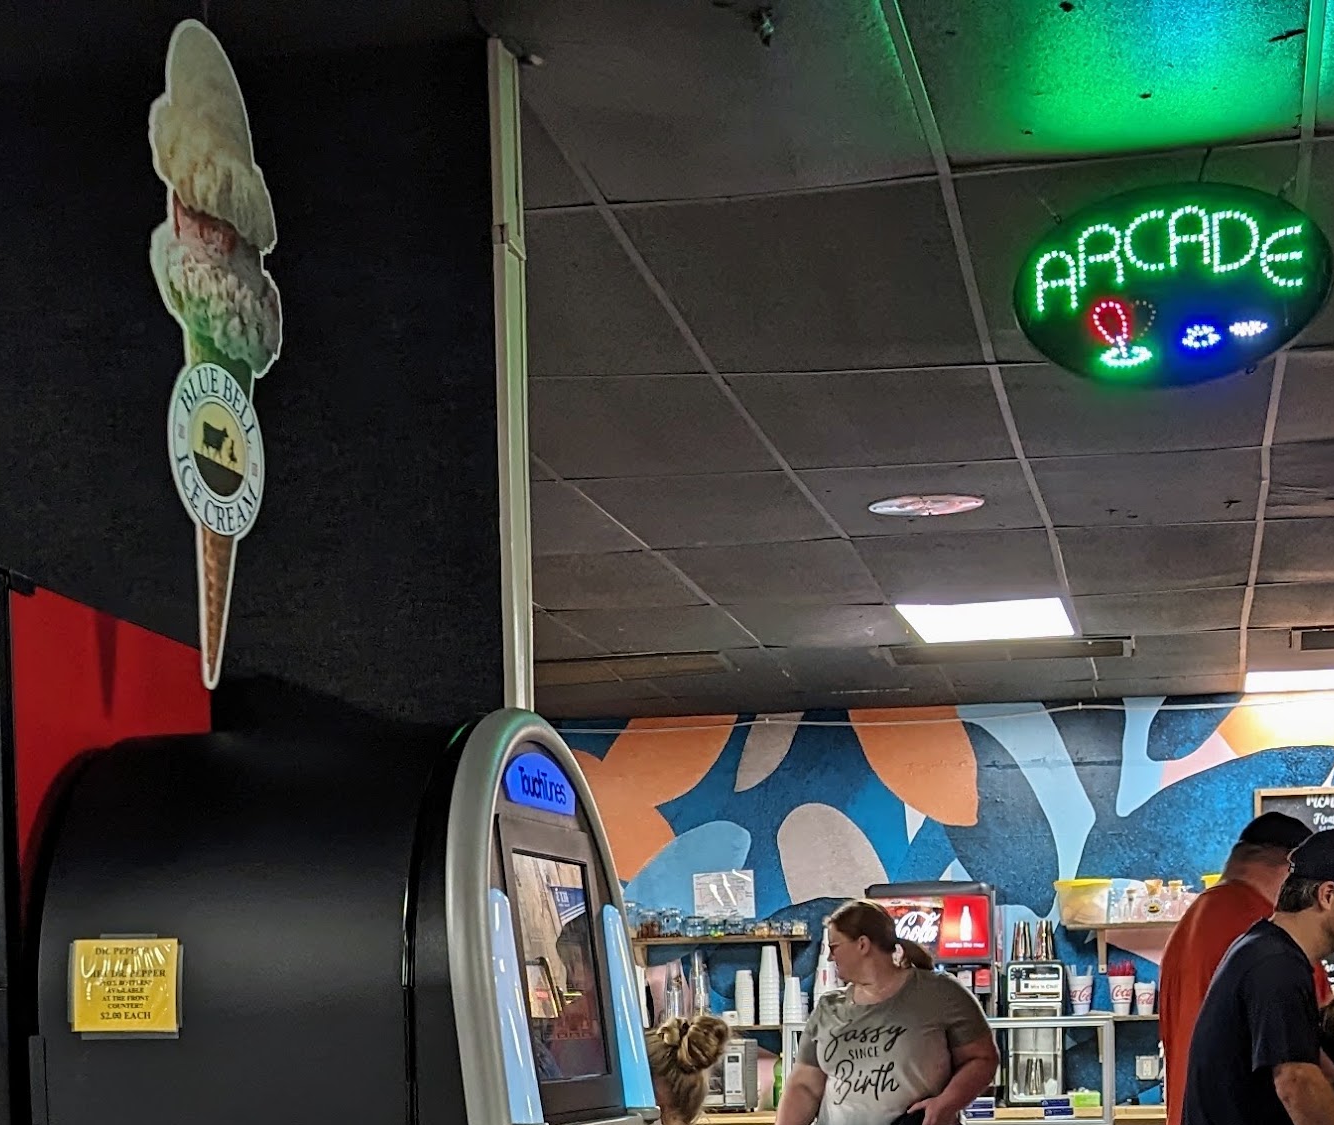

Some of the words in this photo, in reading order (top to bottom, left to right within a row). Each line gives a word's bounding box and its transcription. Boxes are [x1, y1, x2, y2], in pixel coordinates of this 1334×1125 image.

[1035, 204, 1304, 314] ARCADE
[180, 366, 219, 413] BLUE
[177, 454, 203, 509] ICE
[204, 483, 258, 533] CREAM
[518, 766, 567, 806] TouchTunes
[130, 969, 166, 978] PEPPER
[124, 1011, 151, 1020] EACH
[824, 1019, 907, 1062] Sassy
[848, 1046, 880, 1060] SINCE
[833, 1059, 900, 1105] Birth
